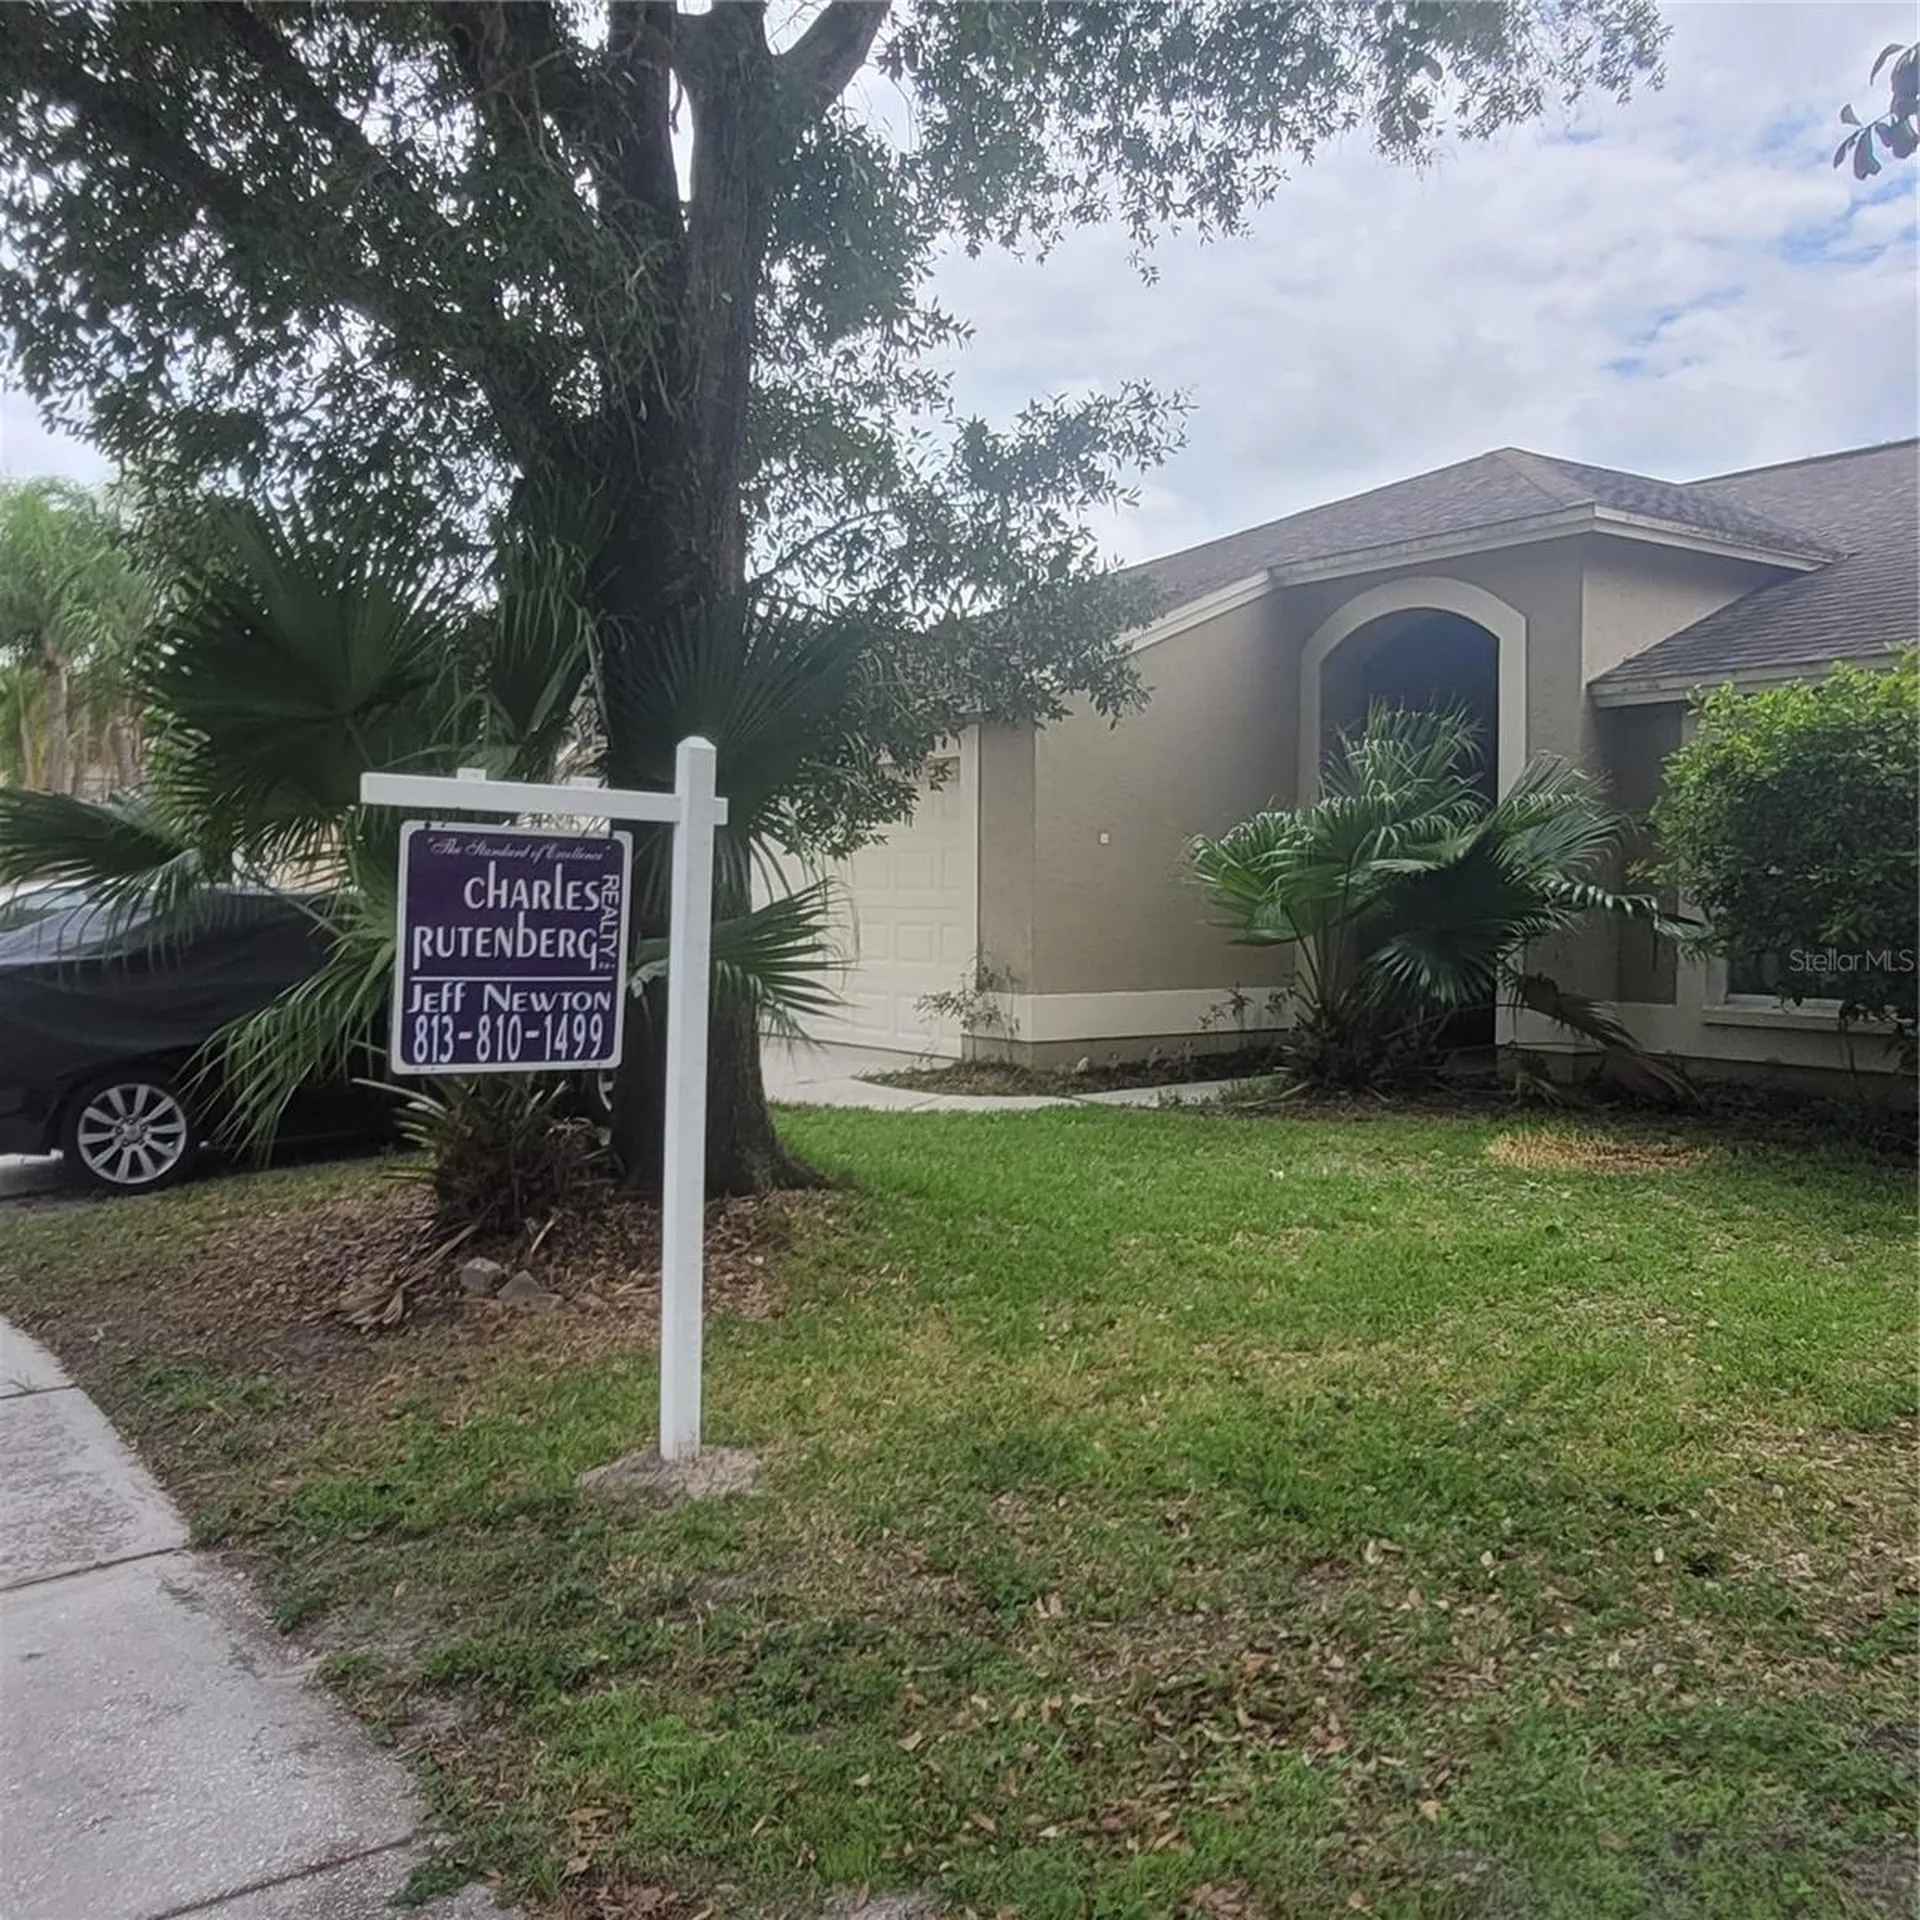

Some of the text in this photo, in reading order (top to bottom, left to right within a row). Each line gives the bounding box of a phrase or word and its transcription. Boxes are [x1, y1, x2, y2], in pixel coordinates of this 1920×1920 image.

[464, 838, 530, 859] Standard
[531, 843, 545, 864] of
[599, 874, 620, 958] REALTY
[413, 1012, 603, 1063] 813-810-1499
